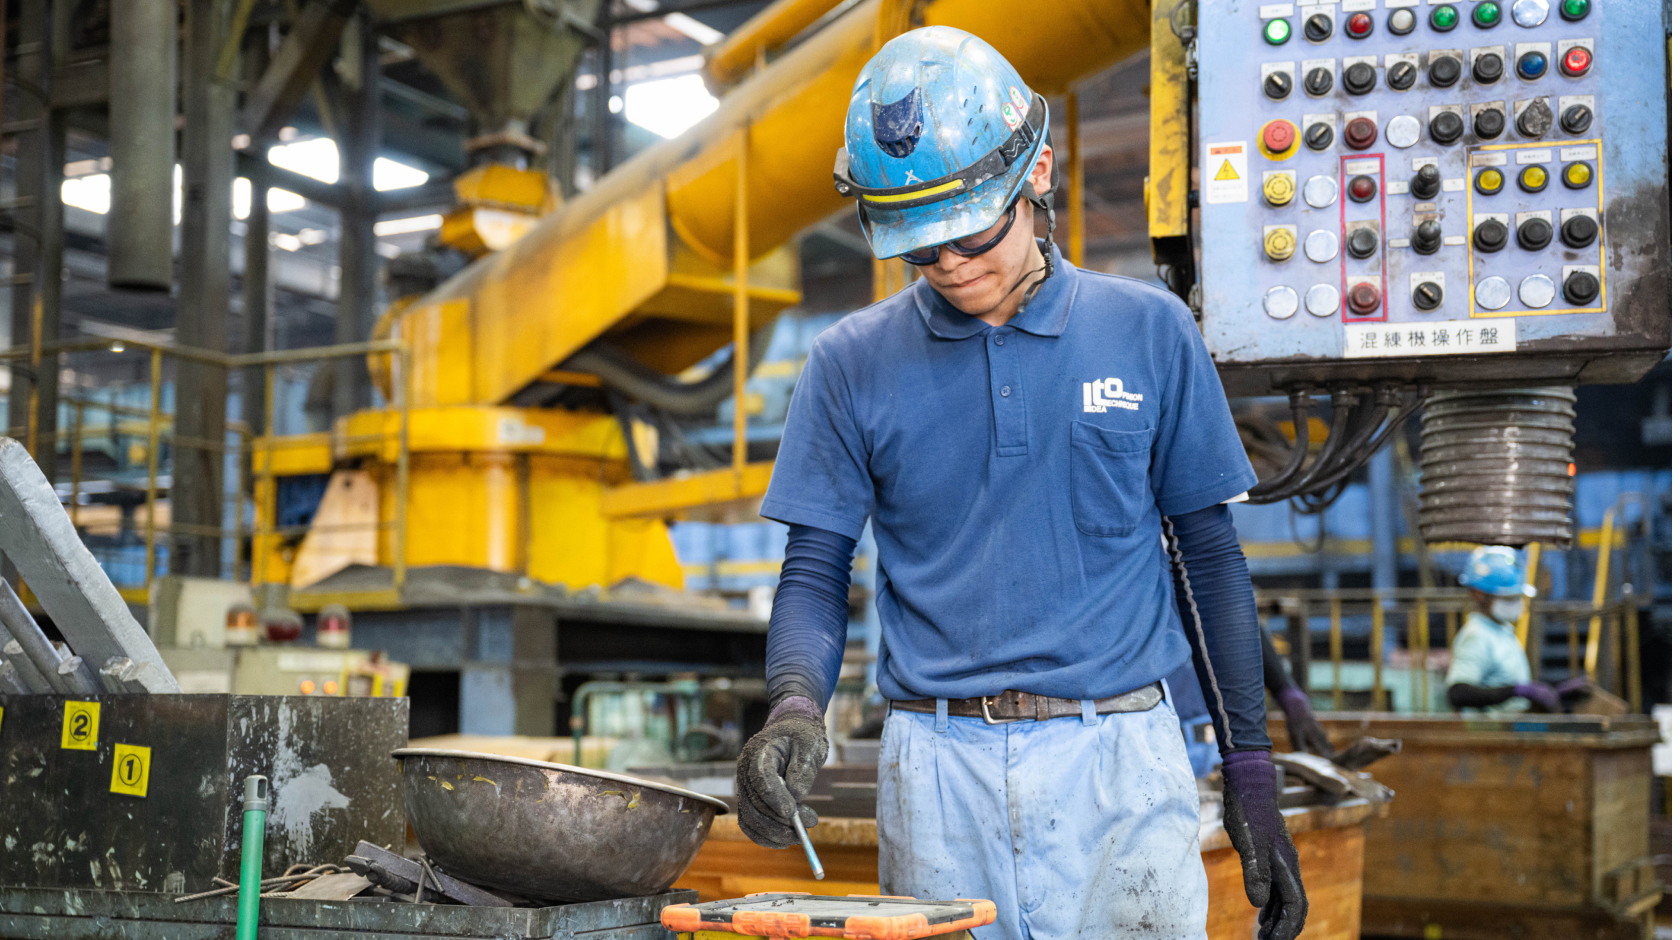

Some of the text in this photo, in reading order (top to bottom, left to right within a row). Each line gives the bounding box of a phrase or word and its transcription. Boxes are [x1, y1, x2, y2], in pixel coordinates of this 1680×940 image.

[1360, 328, 1499, 349] 混練機操作盤
